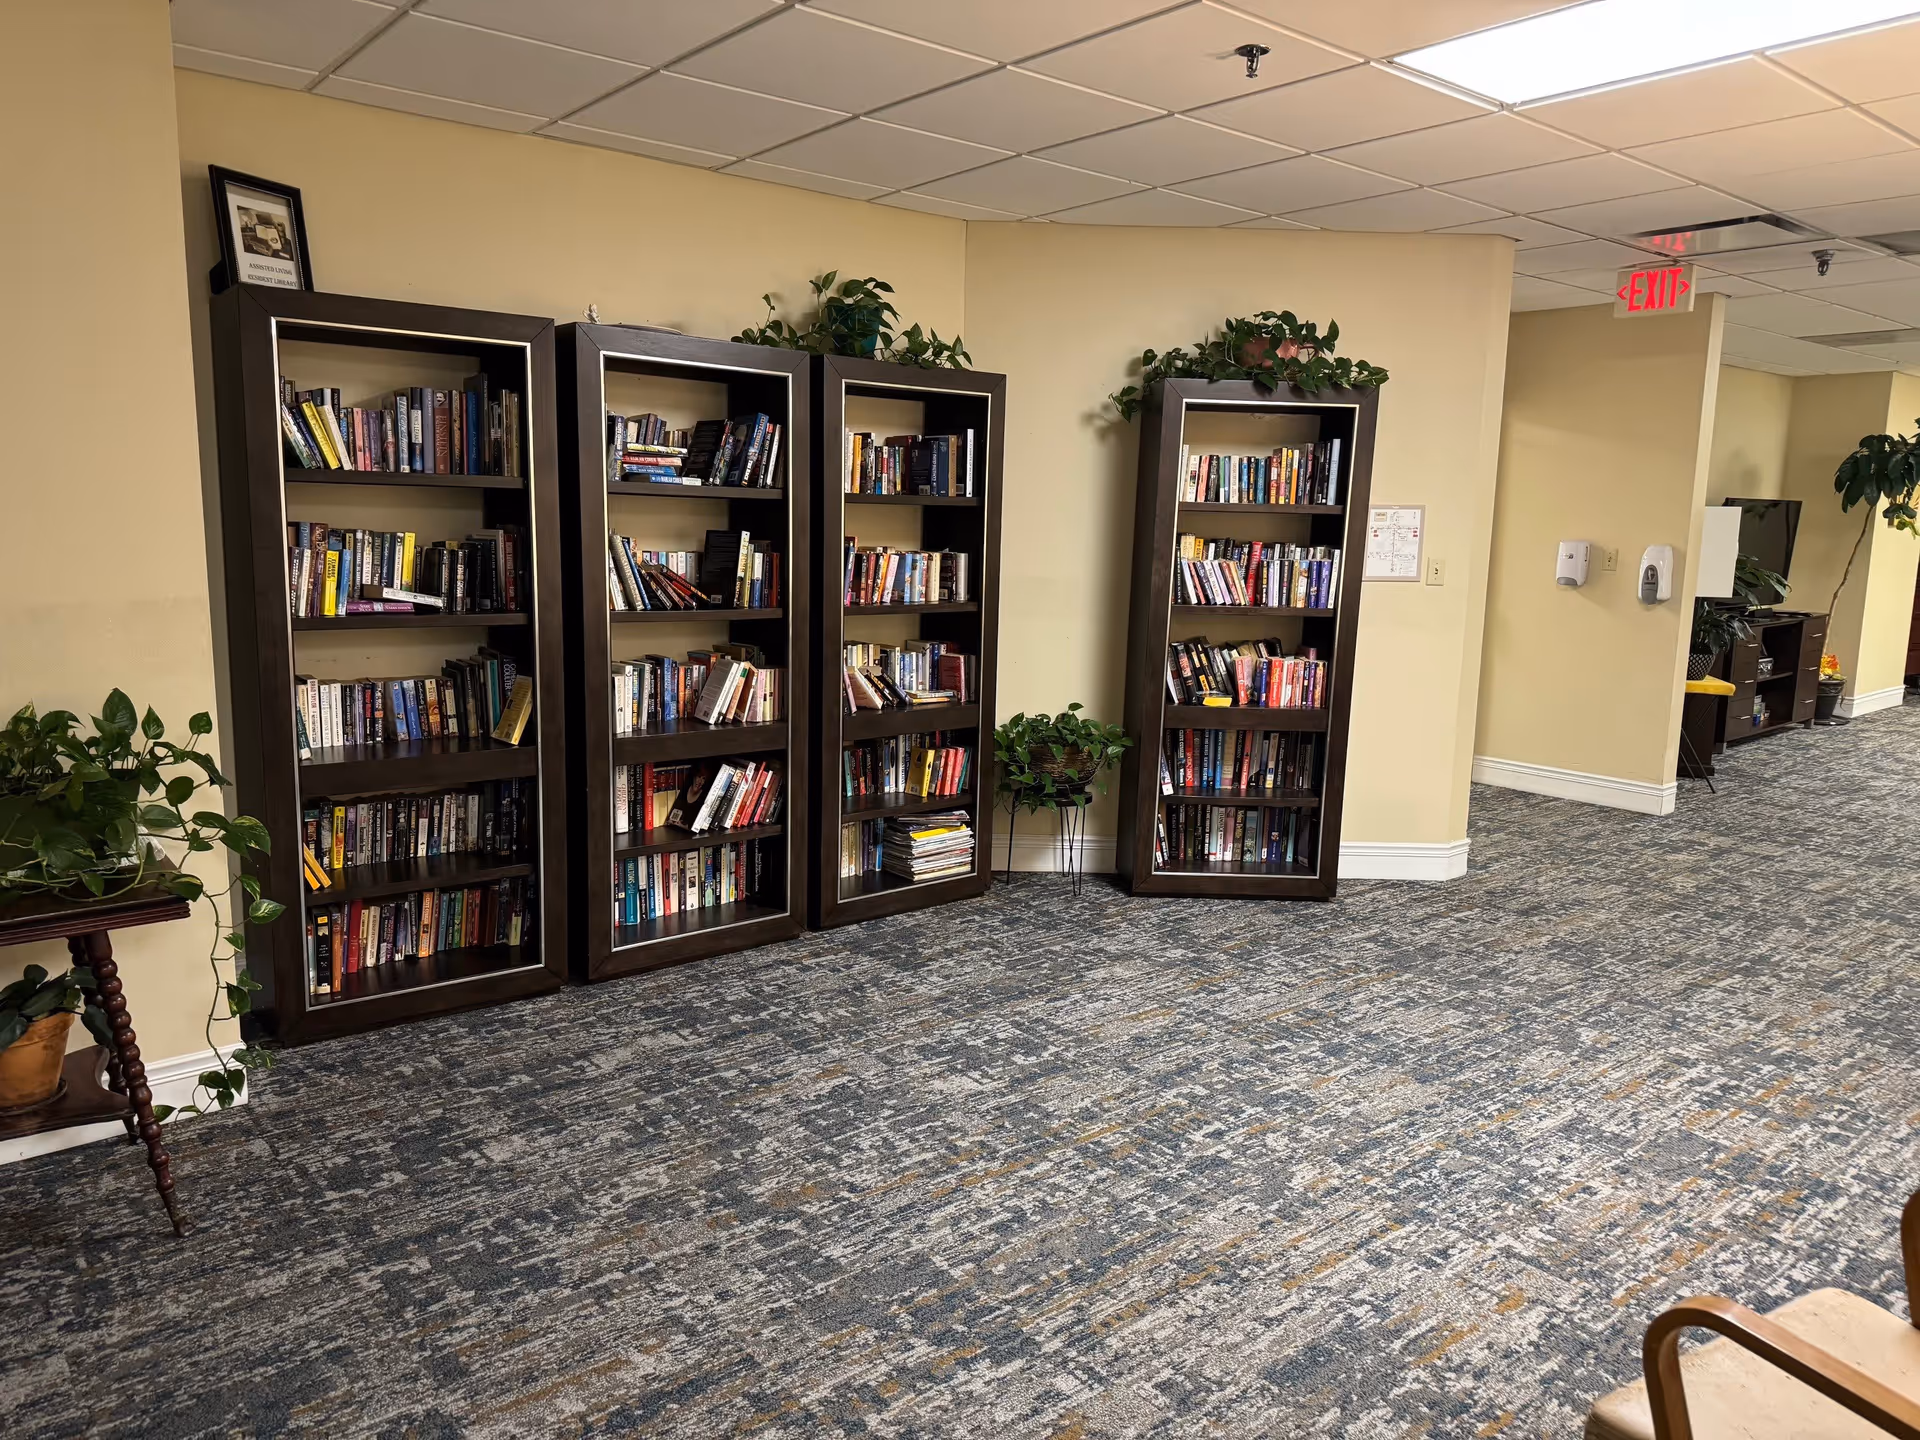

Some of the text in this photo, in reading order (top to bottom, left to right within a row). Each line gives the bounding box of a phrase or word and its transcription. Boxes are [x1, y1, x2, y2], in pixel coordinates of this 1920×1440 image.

[247, 273, 298, 287] RESIDENT LIBRARY
[249, 262, 293, 276] ASSISTED LIVING
[1628, 267, 1684, 312] EXIT
[439, 415, 448, 457] EINSTEIN
[504, 663, 512, 690] COULTER
[335, 846, 343, 865] THERAPY
